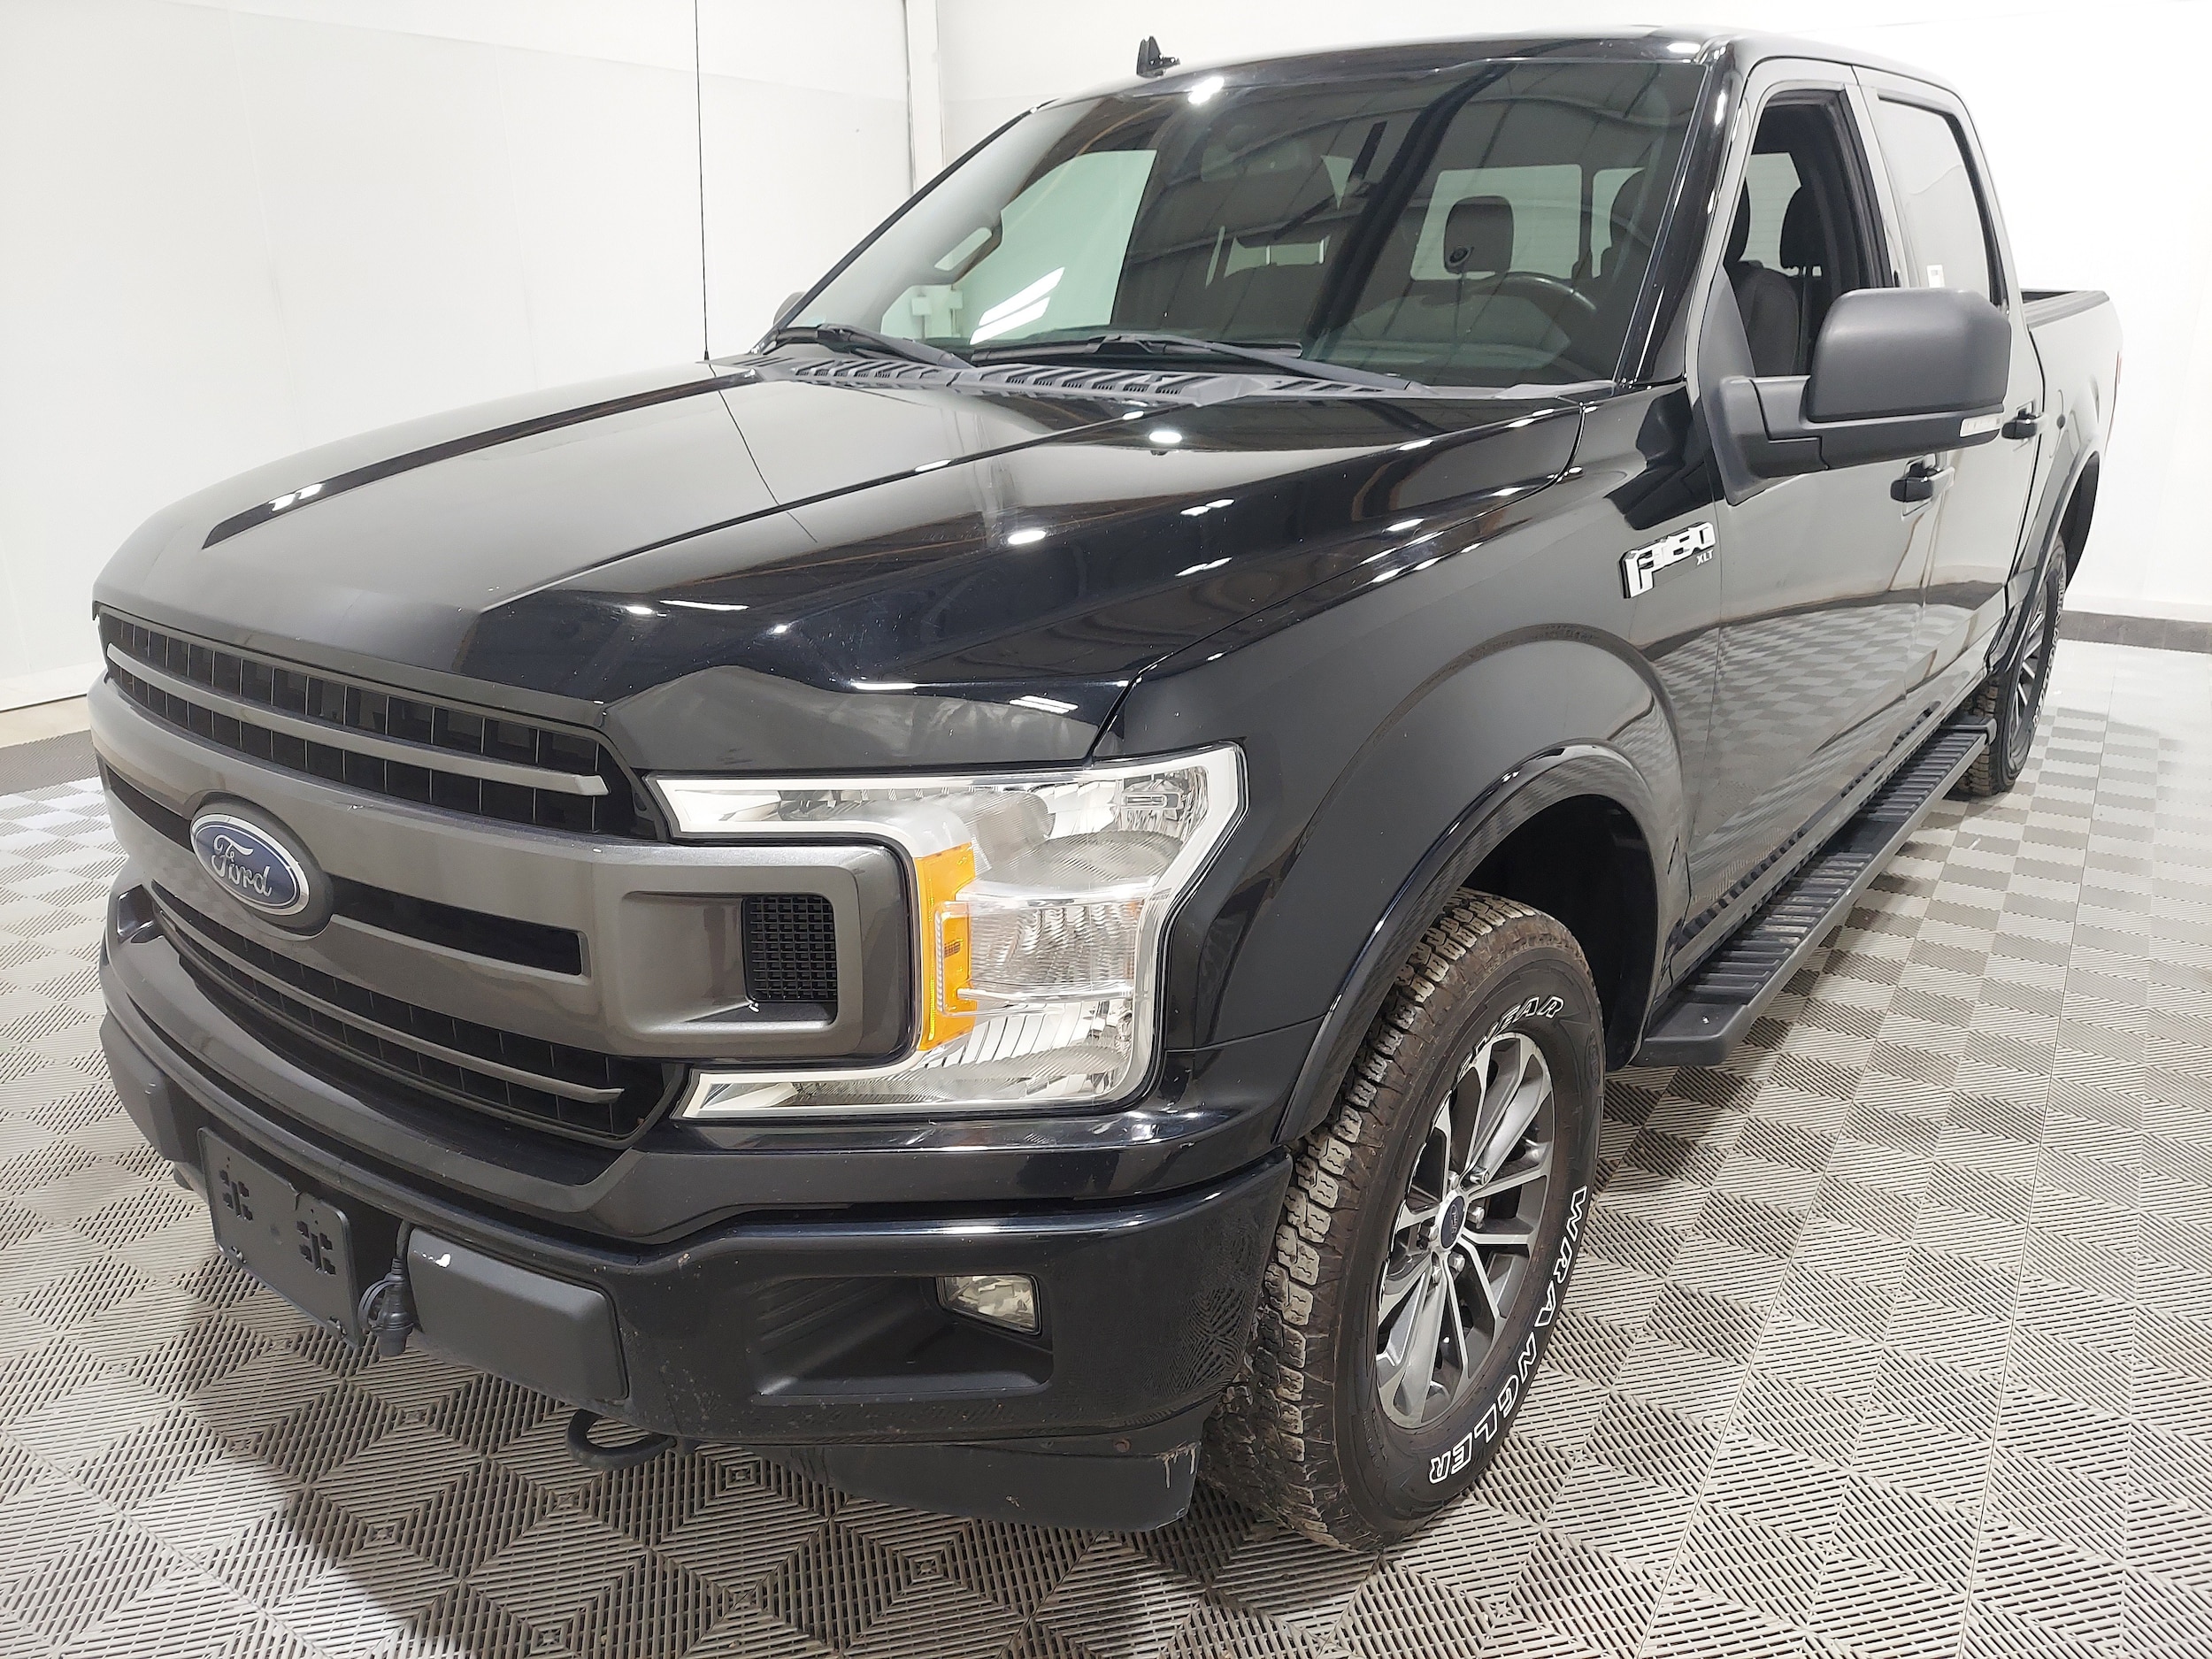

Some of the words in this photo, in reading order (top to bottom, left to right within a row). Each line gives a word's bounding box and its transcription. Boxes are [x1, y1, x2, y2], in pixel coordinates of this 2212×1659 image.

[1696, 549, 1714, 566] XLT
[211, 834, 273, 897] Ford
[1429, 1185, 1587, 1486] WRANGLER
